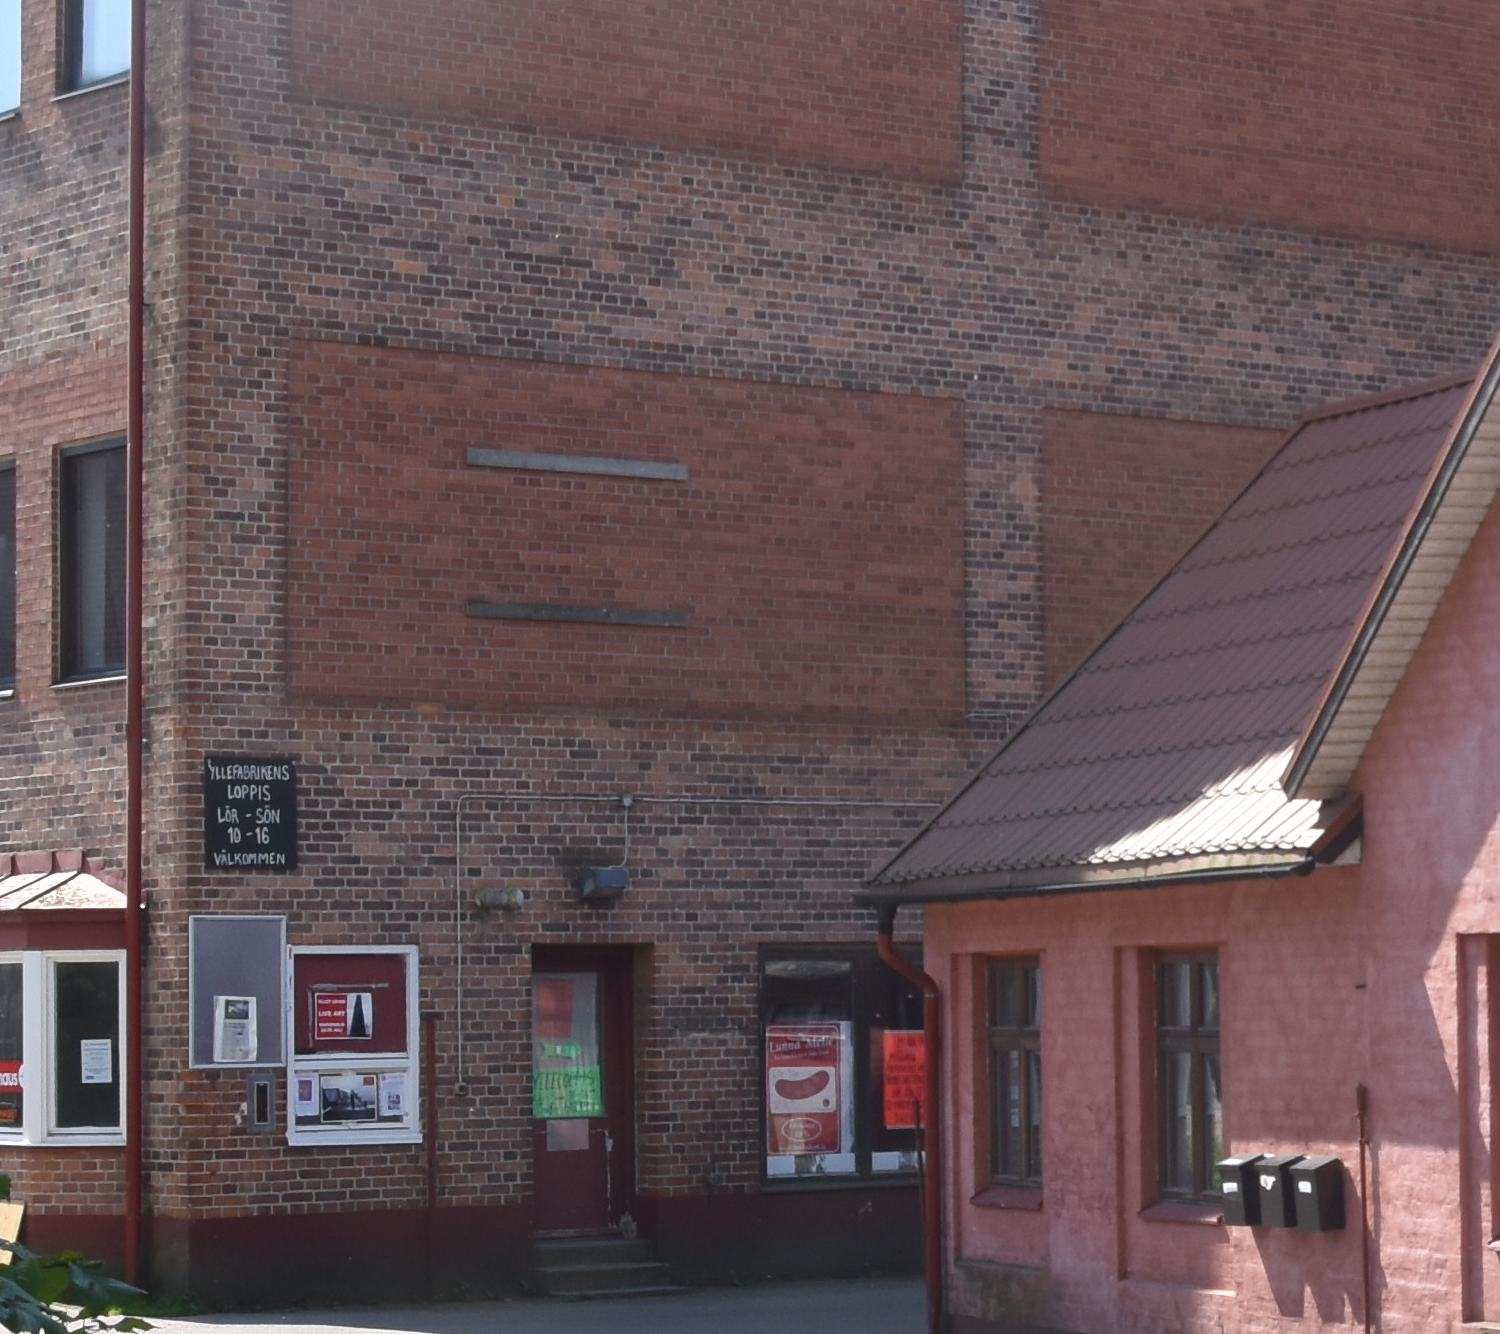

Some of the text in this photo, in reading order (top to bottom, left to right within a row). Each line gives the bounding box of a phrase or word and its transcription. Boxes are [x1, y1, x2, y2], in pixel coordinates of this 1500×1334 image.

[207, 759, 290, 781] YLLEFABRIKENS
[228, 784, 271, 801] LOPPIS
[217, 805, 239, 823] LÖR
[255, 805, 280, 824] SÖN
[227, 826, 241, 844] 10
[255, 826, 270, 844] 16
[213, 849, 285, 866] VÄLKOMMEN
